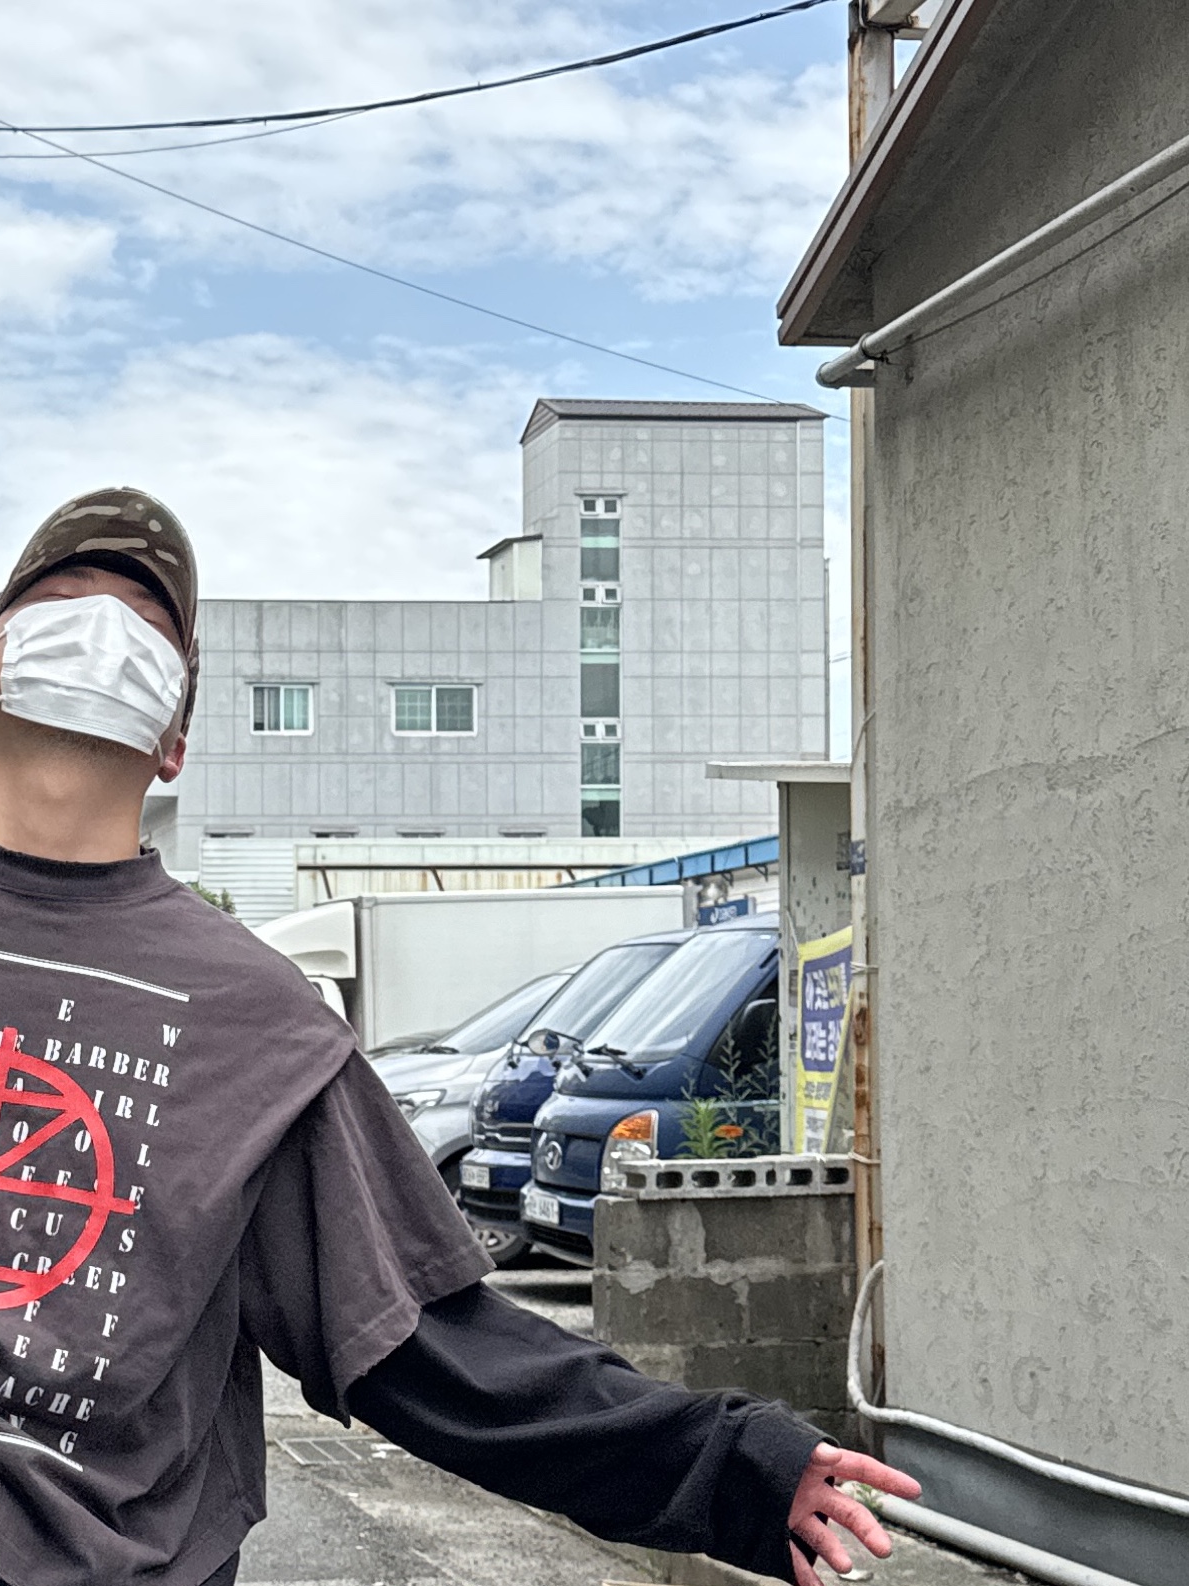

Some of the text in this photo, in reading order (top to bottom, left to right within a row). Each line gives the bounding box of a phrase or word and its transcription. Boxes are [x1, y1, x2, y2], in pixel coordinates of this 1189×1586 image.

[44, 1038, 171, 1087] BARBER
[93, 1089, 160, 1127] IRL
[10, 1207, 137, 1253] CUS
